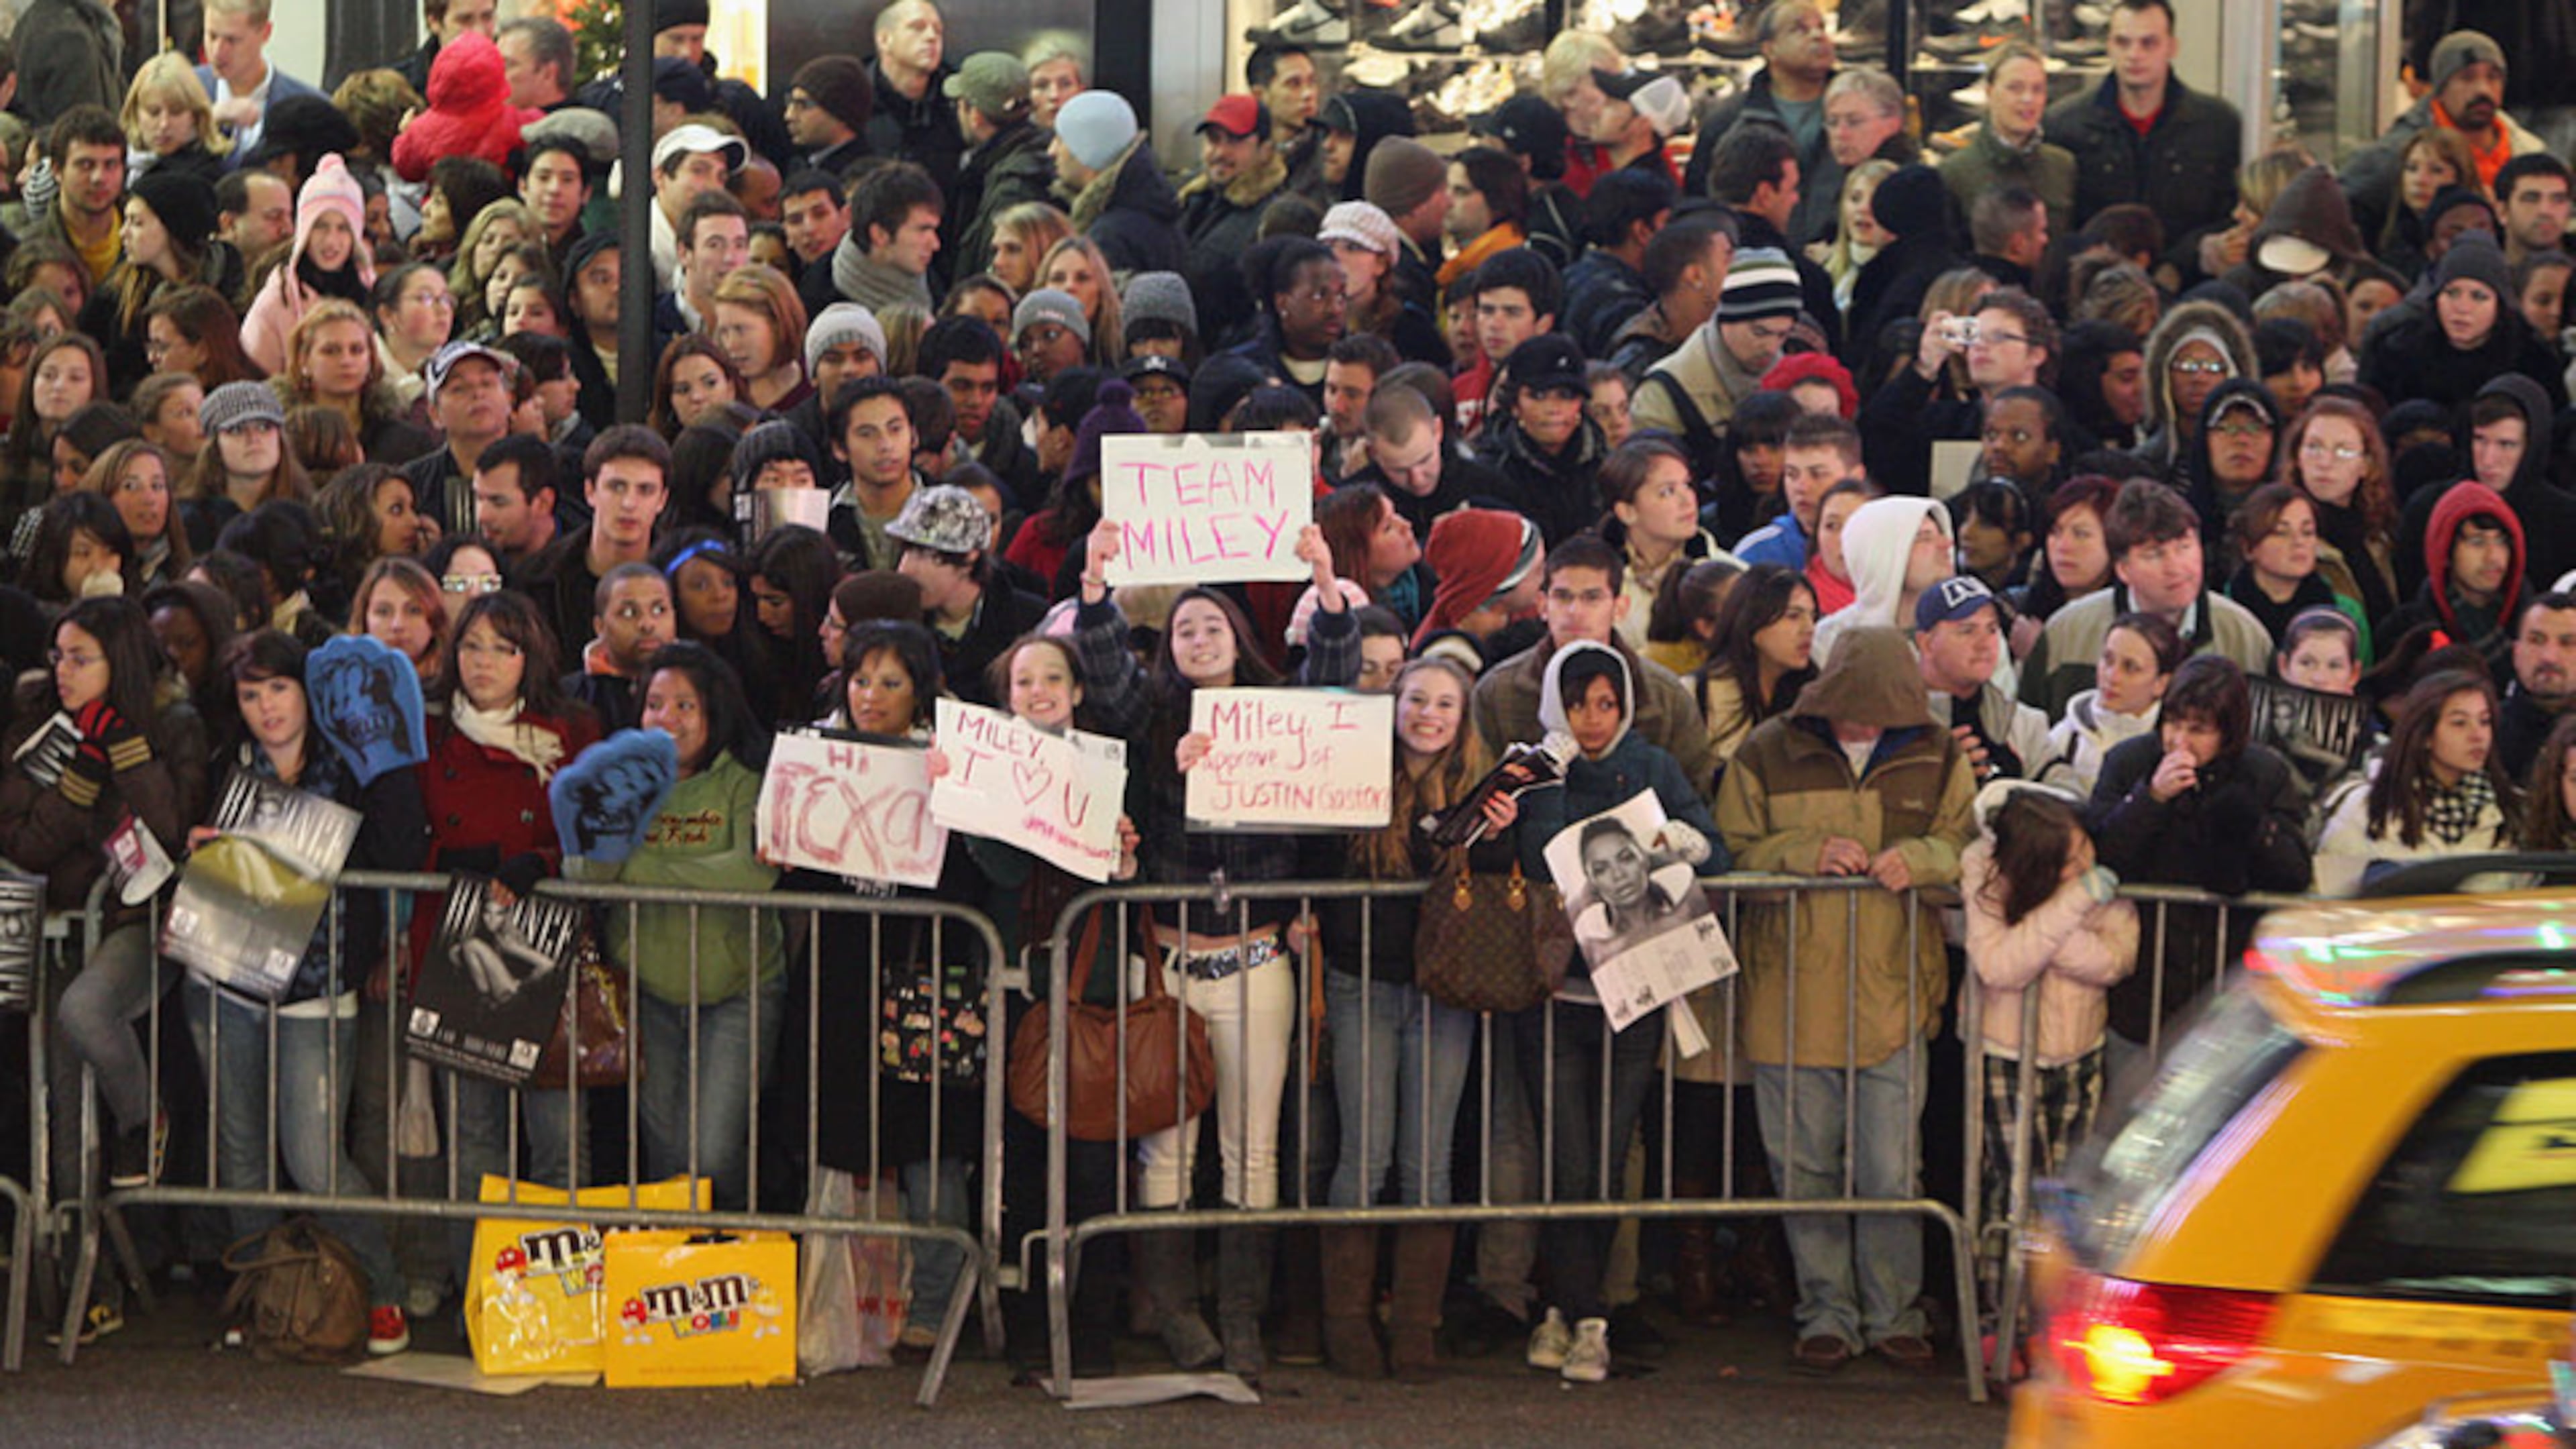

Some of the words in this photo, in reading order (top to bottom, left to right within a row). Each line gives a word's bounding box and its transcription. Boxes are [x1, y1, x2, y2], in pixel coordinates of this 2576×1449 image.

[1118, 459, 1275, 508] TEAM
[1122, 510, 1289, 571] MILEY
[1327, 700, 1361, 730] I
[827, 744, 869, 775] Hi
[1202, 747, 1278, 777] approve
[1311, 745, 1335, 771] of
[955, 745, 994, 786] I
[1063, 782, 1091, 829] U
[1210, 781, 1313, 810] JUSTIN
